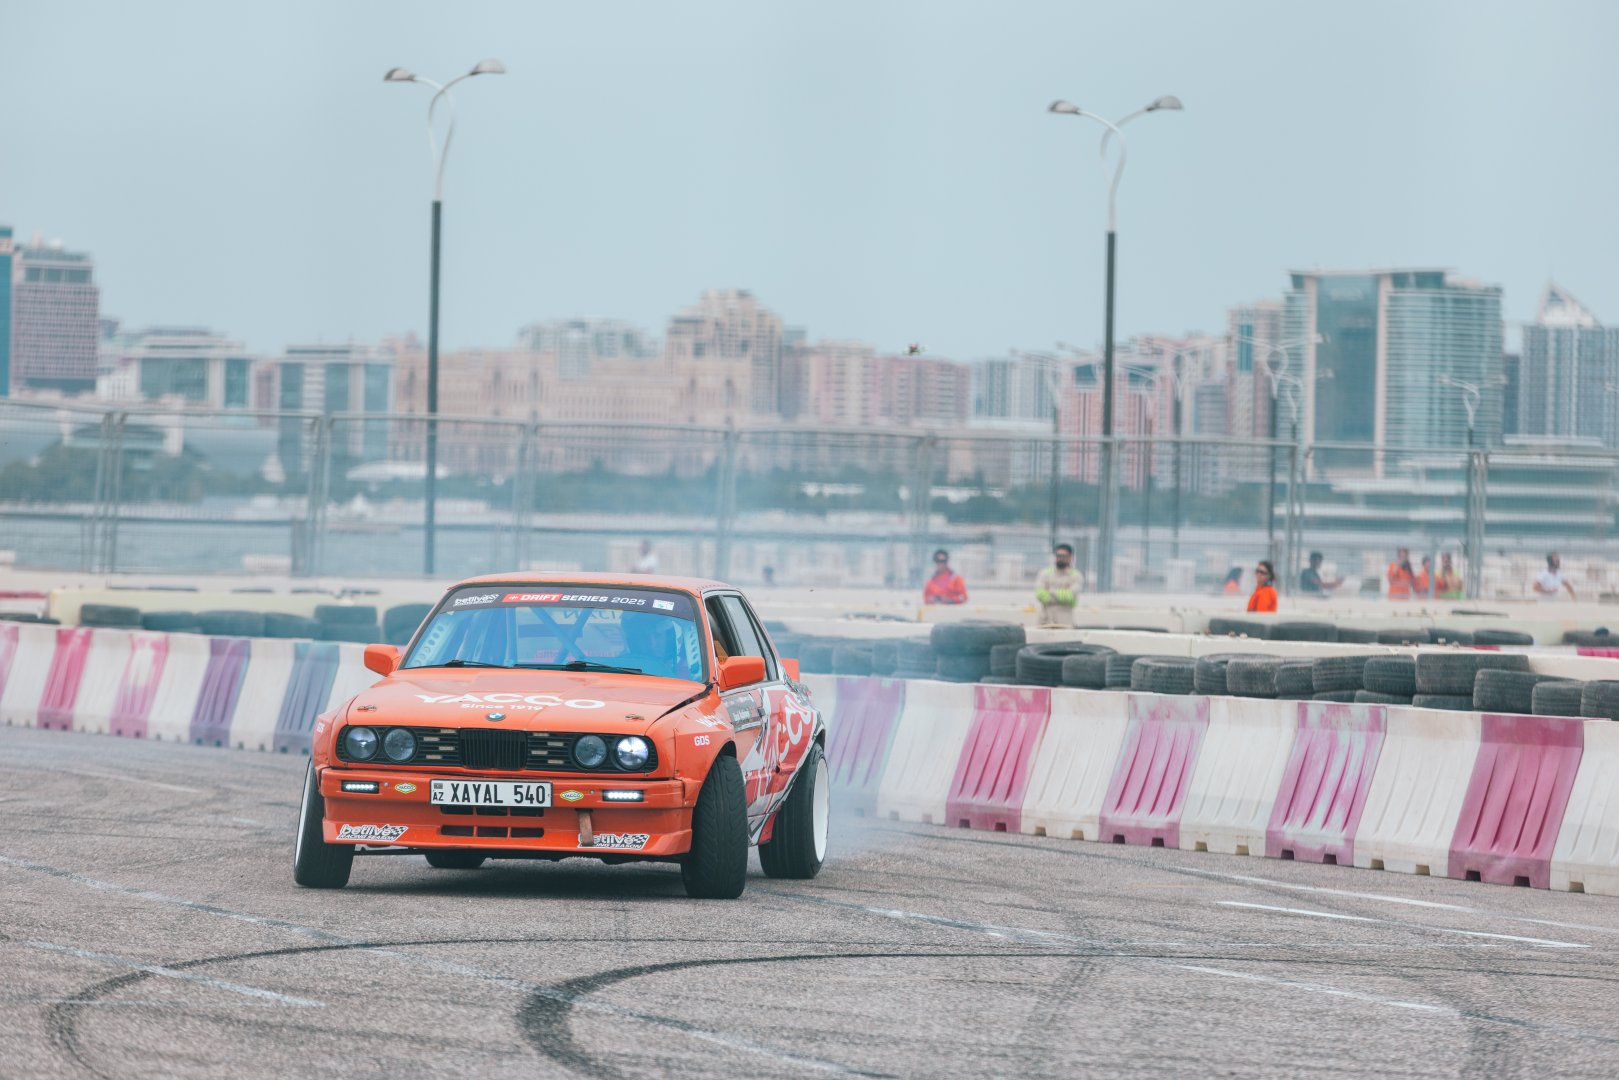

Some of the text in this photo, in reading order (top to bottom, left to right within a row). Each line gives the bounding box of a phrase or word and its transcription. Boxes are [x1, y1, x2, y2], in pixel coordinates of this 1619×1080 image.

[520, 594, 560, 602] DRIFT
[561, 594, 608, 603] SERIES
[610, 596, 647, 606] 2025
[415, 693, 606, 709] YACCO
[694, 735, 710, 746] GDS
[432, 791, 444, 802] AZ
[450, 783, 546, 805] XAYAL 540
[342, 824, 391, 836] betlive
